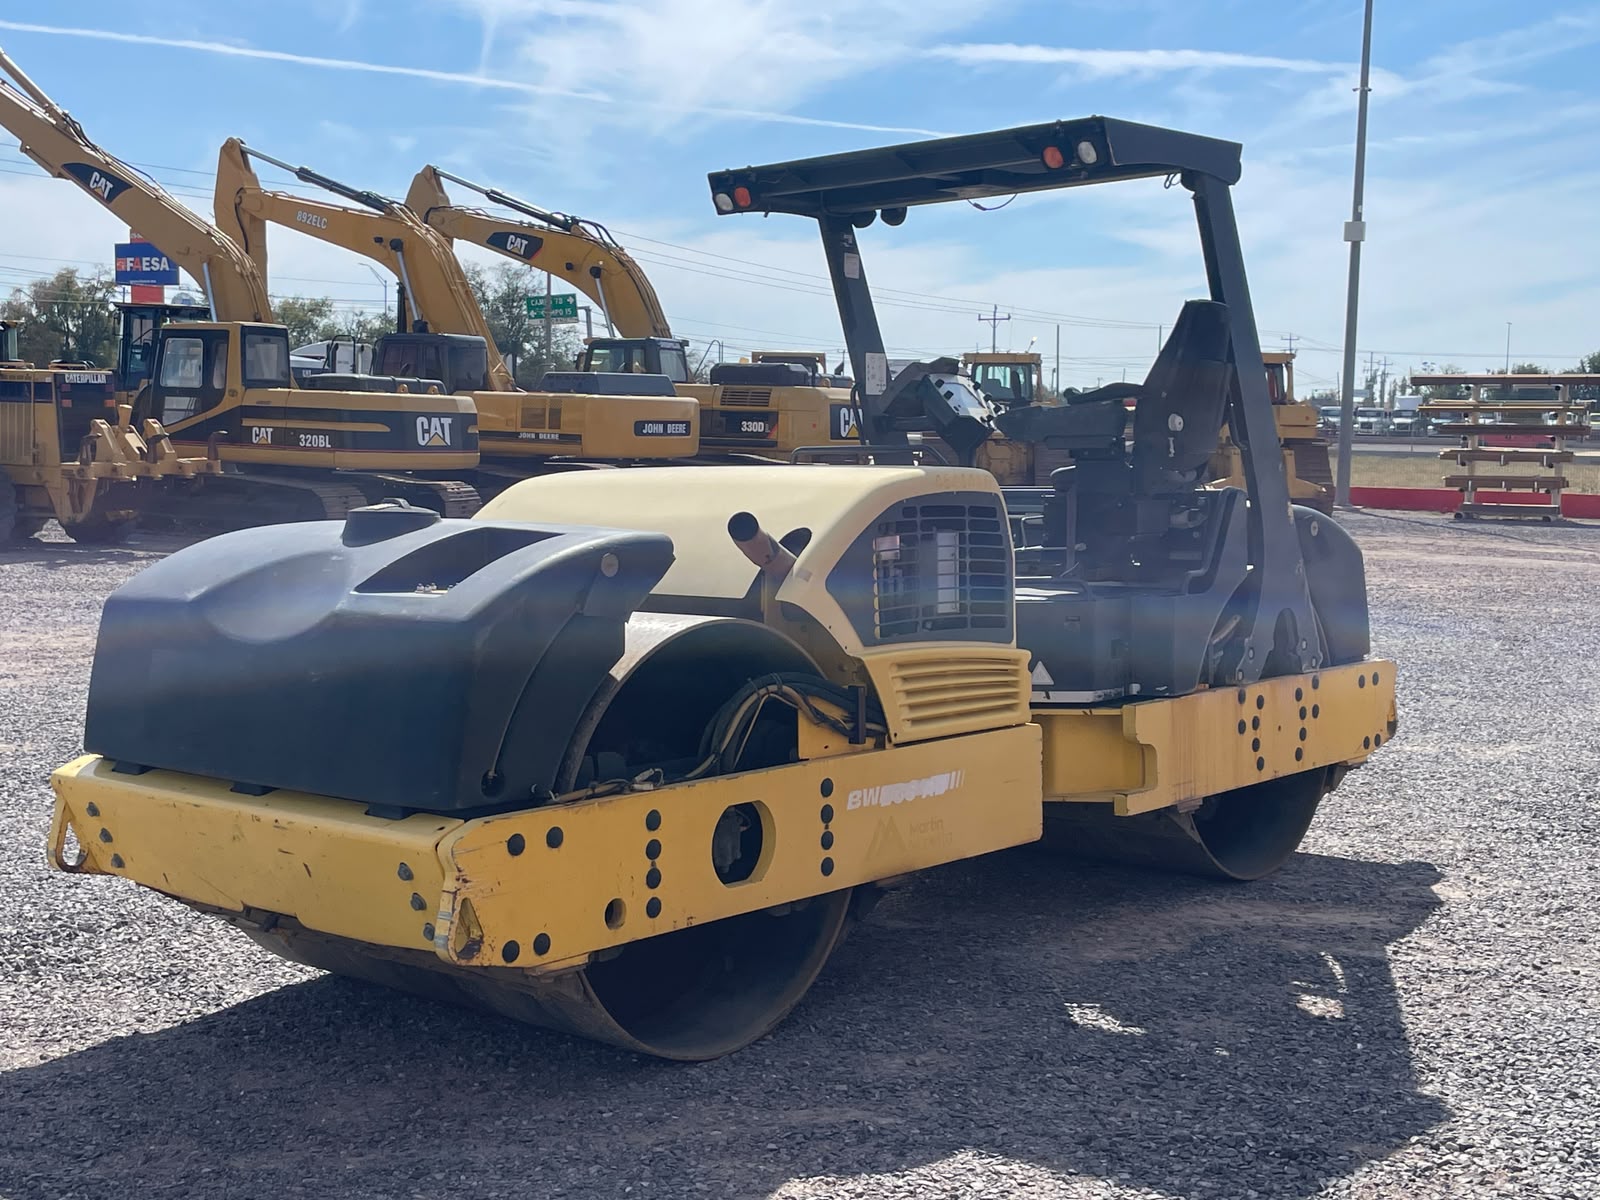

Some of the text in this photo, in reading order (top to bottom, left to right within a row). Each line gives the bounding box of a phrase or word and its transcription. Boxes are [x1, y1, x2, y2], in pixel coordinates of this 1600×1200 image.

[89, 171, 113, 198] CAT
[296, 211, 328, 229] 892ELC
[506, 234, 528, 255] CAT
[126, 256, 170, 272] FAESA
[65, 373, 107, 384] CATERPILLAR
[416, 416, 452, 446] CAT
[642, 423, 687, 434] JOHN DEERE
[741, 421, 765, 433] 330D
[252, 427, 273, 445] CAT
[299, 434, 331, 447] 320BL
[518, 431, 560, 440] JOHN DEERE
